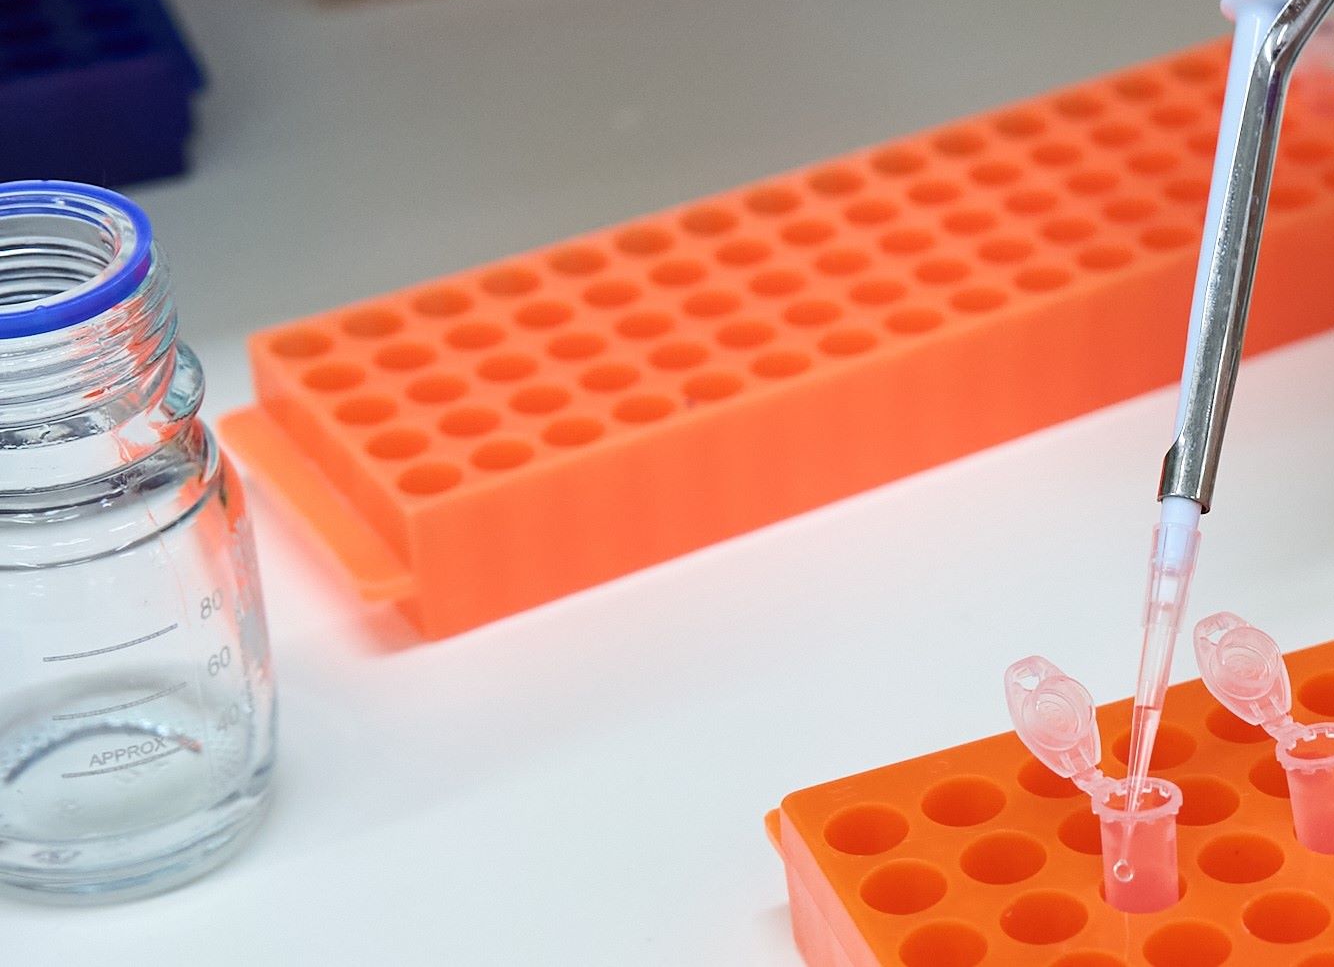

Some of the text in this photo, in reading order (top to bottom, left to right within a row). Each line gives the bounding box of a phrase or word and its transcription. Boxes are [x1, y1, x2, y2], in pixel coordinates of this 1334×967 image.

[200, 588, 224, 620] 80
[207, 645, 231, 677] 60
[216, 702, 240, 732] 40
[88, 735, 169, 768] APPROX
